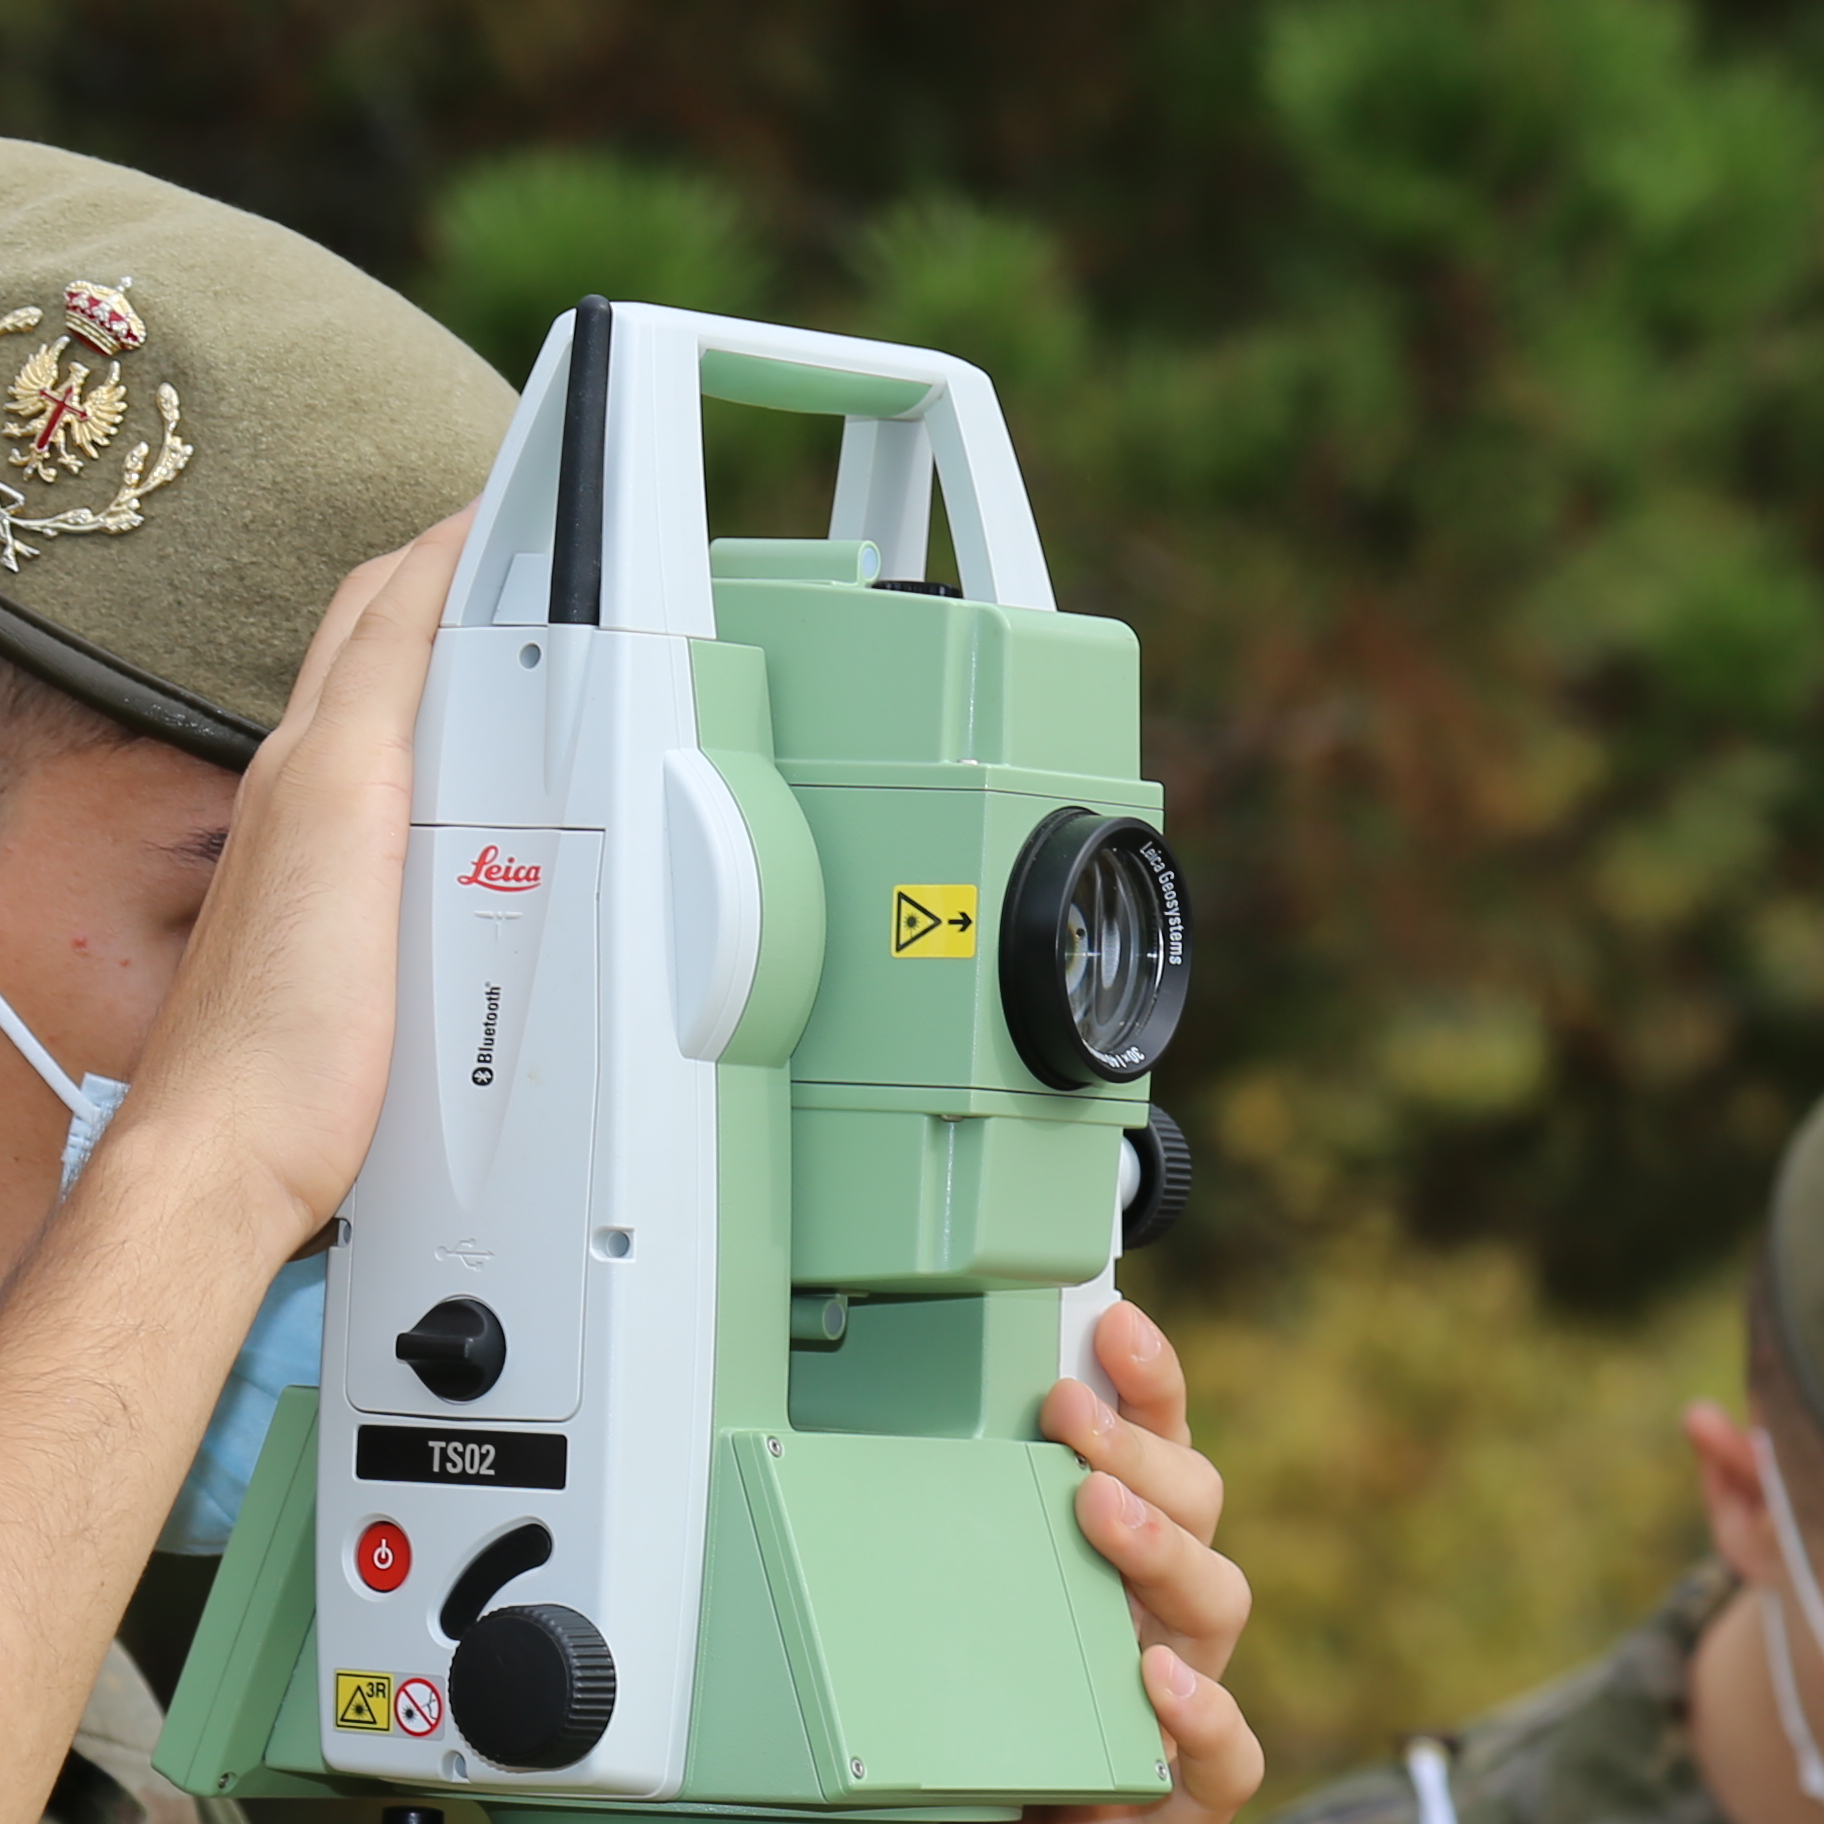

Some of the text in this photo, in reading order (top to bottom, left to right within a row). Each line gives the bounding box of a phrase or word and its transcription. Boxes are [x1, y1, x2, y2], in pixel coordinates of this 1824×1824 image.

[457, 844, 542, 892] Leica
[1139, 841, 1185, 966] Leica Geosystems
[427, 1440, 496, 1475] TS02
[366, 1681, 386, 1699] 3R
